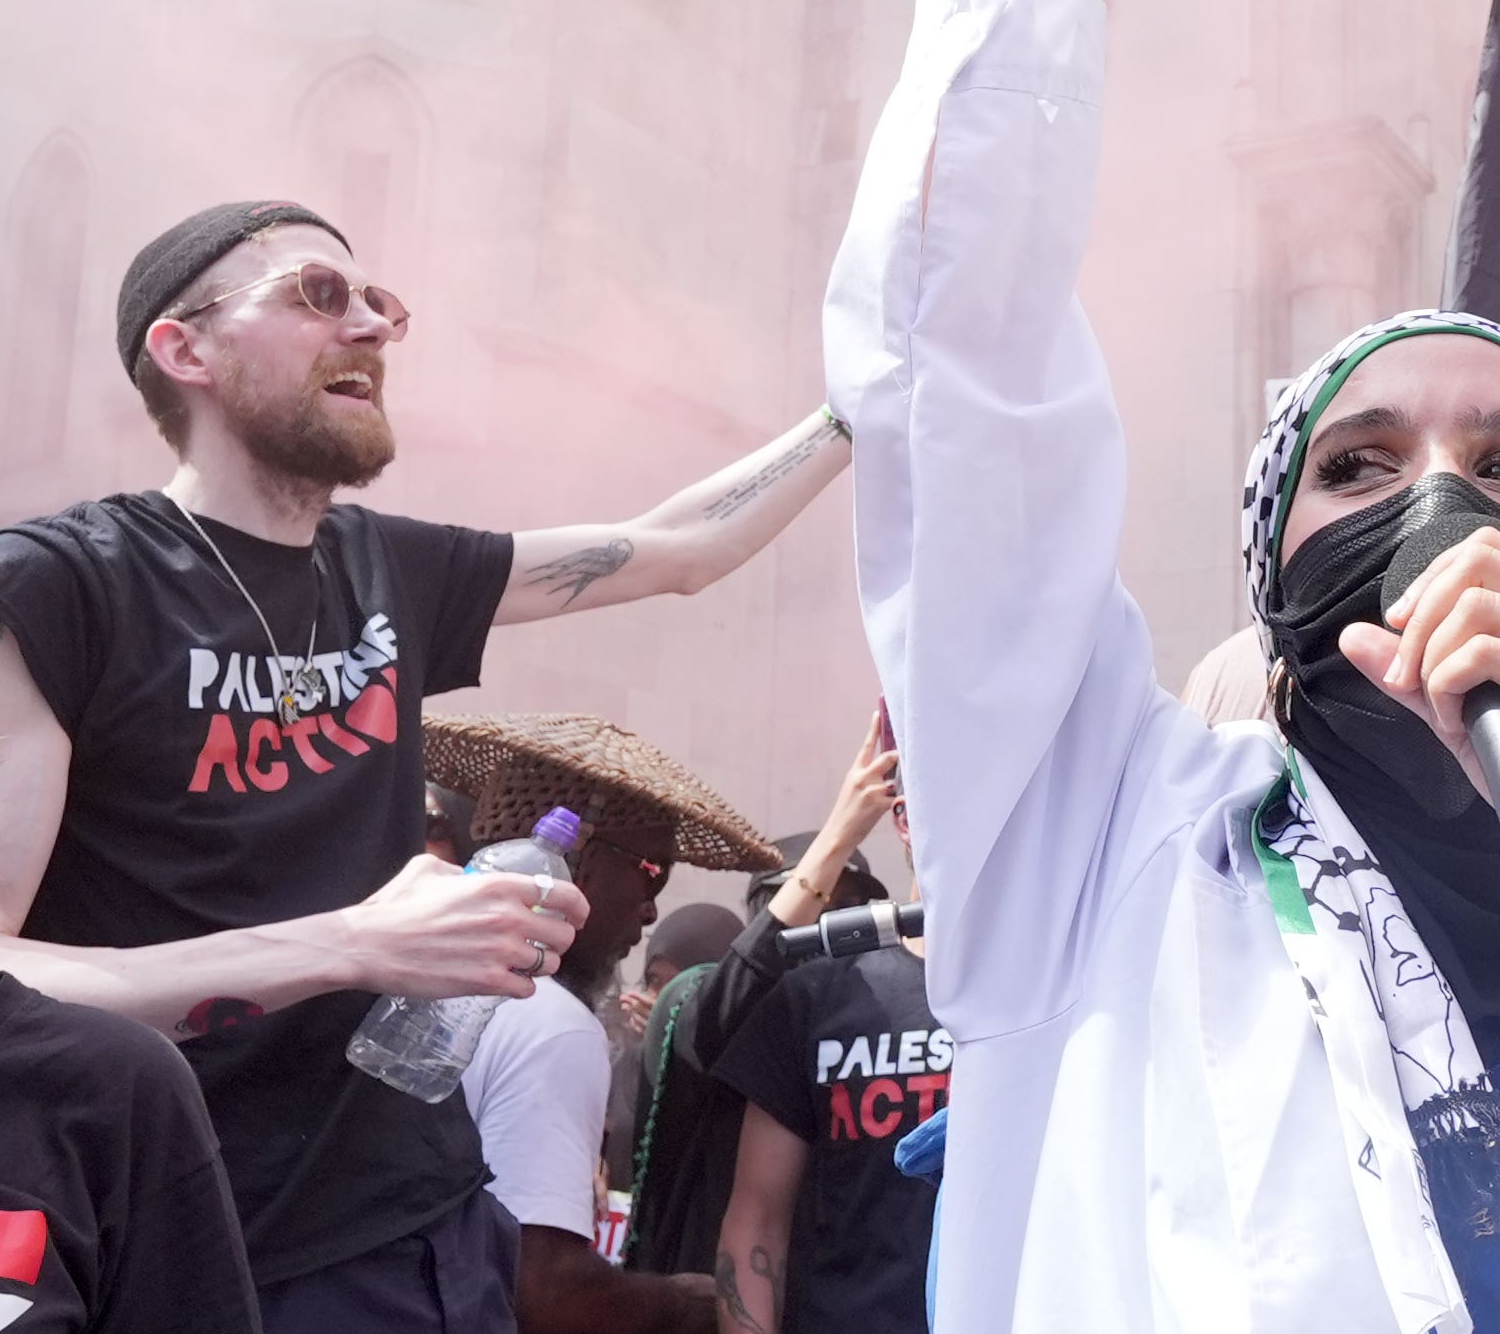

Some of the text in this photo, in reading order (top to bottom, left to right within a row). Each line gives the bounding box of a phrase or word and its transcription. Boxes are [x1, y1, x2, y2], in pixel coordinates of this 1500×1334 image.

[187, 667, 398, 793] ACTIO
[816, 1028, 954, 1084] PALES
[830, 1072, 950, 1141] ACT
